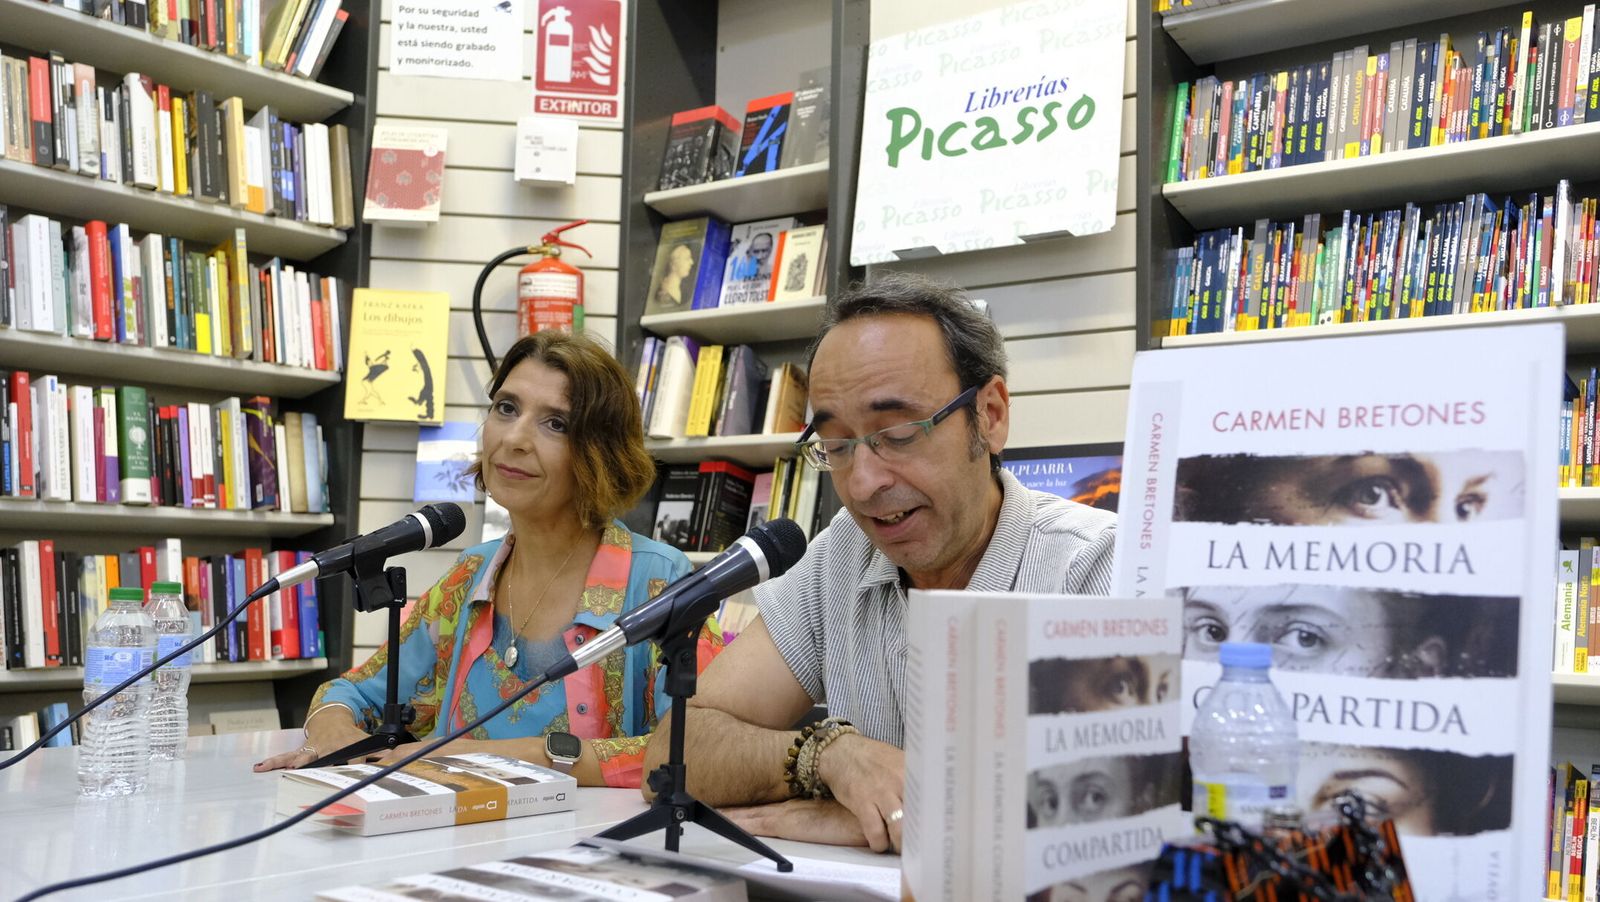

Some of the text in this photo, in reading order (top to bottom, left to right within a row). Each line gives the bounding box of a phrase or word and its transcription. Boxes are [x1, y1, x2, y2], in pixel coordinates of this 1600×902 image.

[398, 21, 488, 34] y la nuestra, usted
[399, 5, 415, 14] Por
[433, 8, 479, 21] seguridad
[398, 38, 496, 52] está siendo grabado
[904, 20, 982, 51] Picasso
[397, 55, 474, 68] y monitorizado.
[939, 47, 1021, 77] Picasso
[1535, 53, 1544, 90] EXTREMADURA
[868, 70, 923, 94] casso
[1401, 75, 1410, 110] CATALUÑA
[1474, 63, 1482, 92] CÓRDOBA
[1591, 77, 1599, 92] AZUL
[540, 99, 612, 115] EXTINTOR
[965, 75, 1070, 114] Librerías
[1388, 78, 1398, 113] CATALUÑA
[1252, 91, 1262, 130] CANTABRIA
[1352, 95, 1360, 125] CASTILLA
[886, 94, 1096, 168] Picasso
[980, 187, 1067, 214] Picasso
[882, 204, 962, 230] Picasso
[1253, 254, 1264, 290] GALICIA
[1460, 255, 1465, 264] LA
[363, 312, 423, 325] Los dibujos
[1212, 400, 1487, 433] CARMEN BRETONES
[1136, 412, 1163, 583] CARMEN BRETONES LA
[1207, 539, 1477, 576] LA MEMORIA
[1561, 582, 1572, 631] Alemania
[1576, 600, 1587, 637] Alemania
[1043, 618, 1169, 639] CARMEN BRETONES
[1193, 685, 1470, 736] CPARTIDA
[1045, 718, 1166, 753] LA MEMORIA
[379, 808, 442, 821] CARMEN BRETONES
[1590, 818, 1598, 840] BERLÍN
[1041, 827, 1166, 870] COMPARTIDA
[1487, 850, 1500, 902] OVELA
